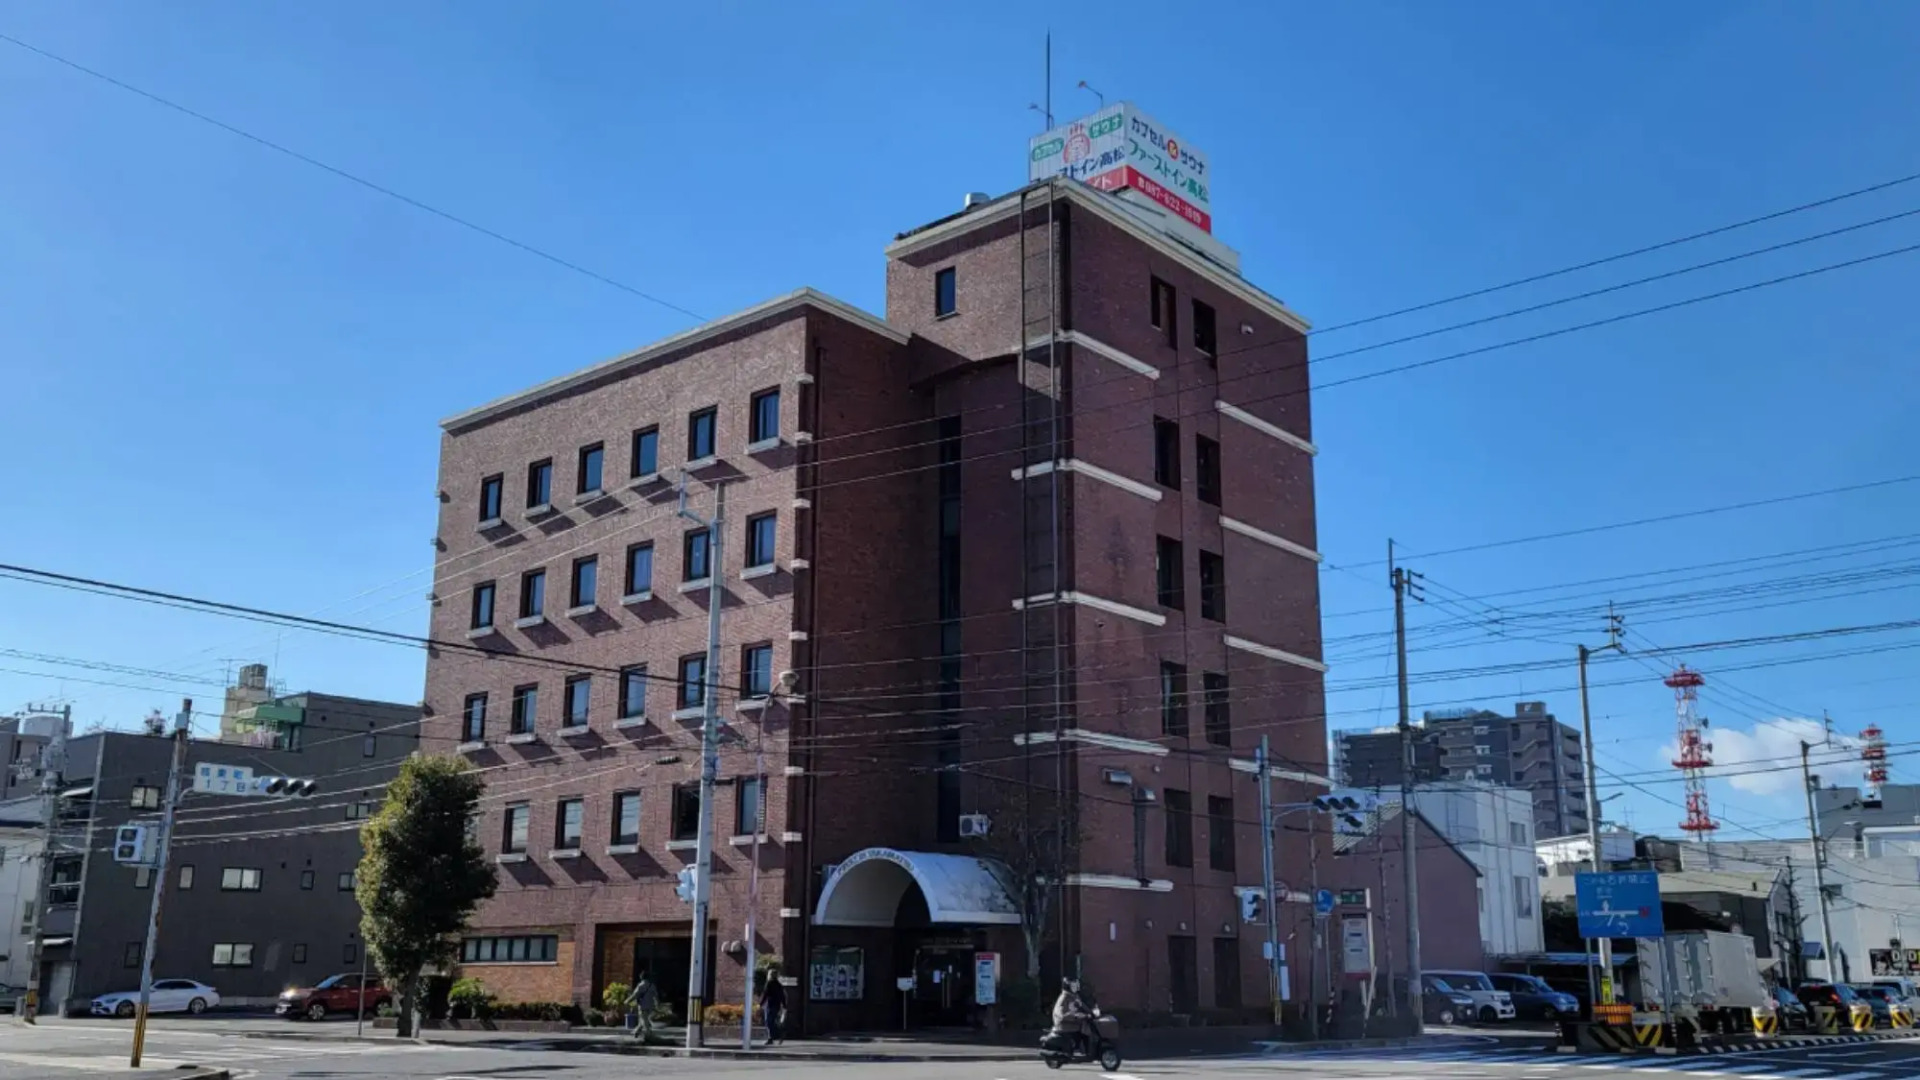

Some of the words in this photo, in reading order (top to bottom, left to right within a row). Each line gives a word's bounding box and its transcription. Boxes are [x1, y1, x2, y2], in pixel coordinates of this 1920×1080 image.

[1128, 138, 1209, 204] ファーストイン高松
